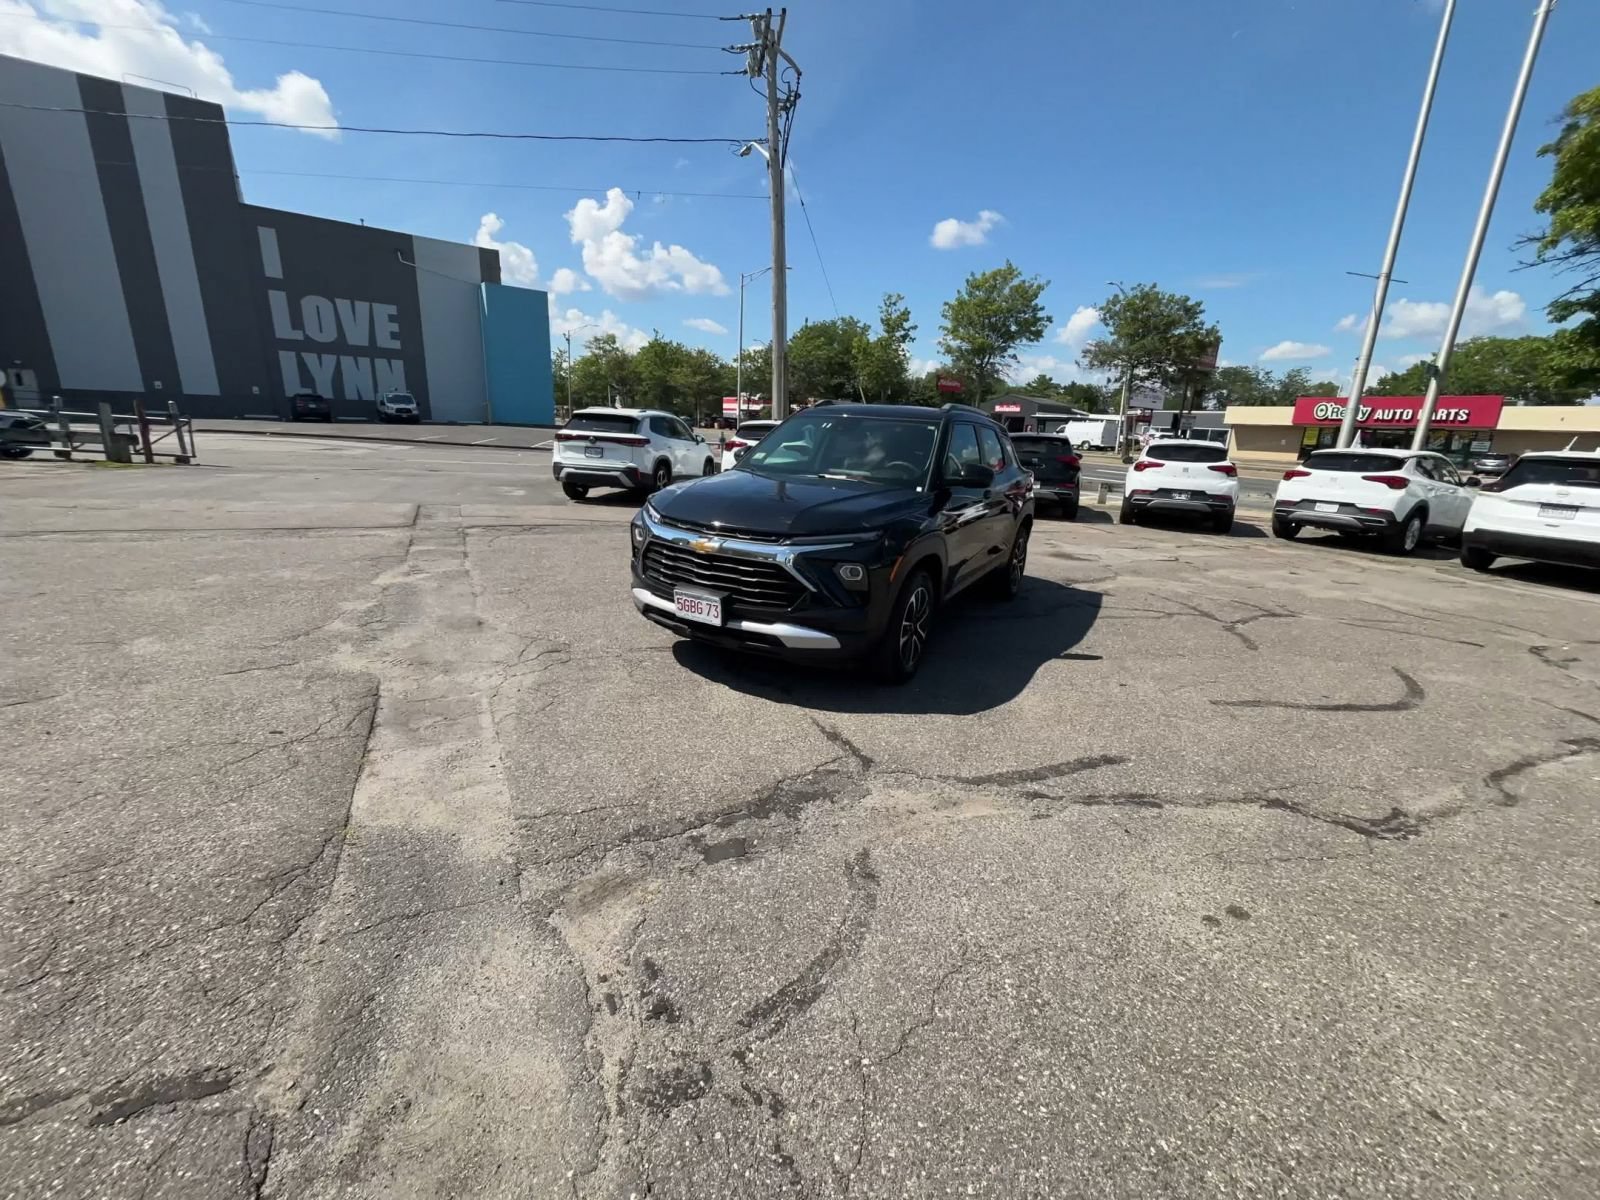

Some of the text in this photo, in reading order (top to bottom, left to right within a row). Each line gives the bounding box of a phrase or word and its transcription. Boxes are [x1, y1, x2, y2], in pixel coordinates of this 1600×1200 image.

[257, 225, 284, 279] I
[267, 289, 401, 349] LOVE
[277, 350, 408, 401] LYNN
[1314, 402, 1371, 421] O'Rey
[1373, 408, 1413, 420] AUTO
[676, 597, 704, 615] 5GBG
[705, 602, 719, 619] 73
